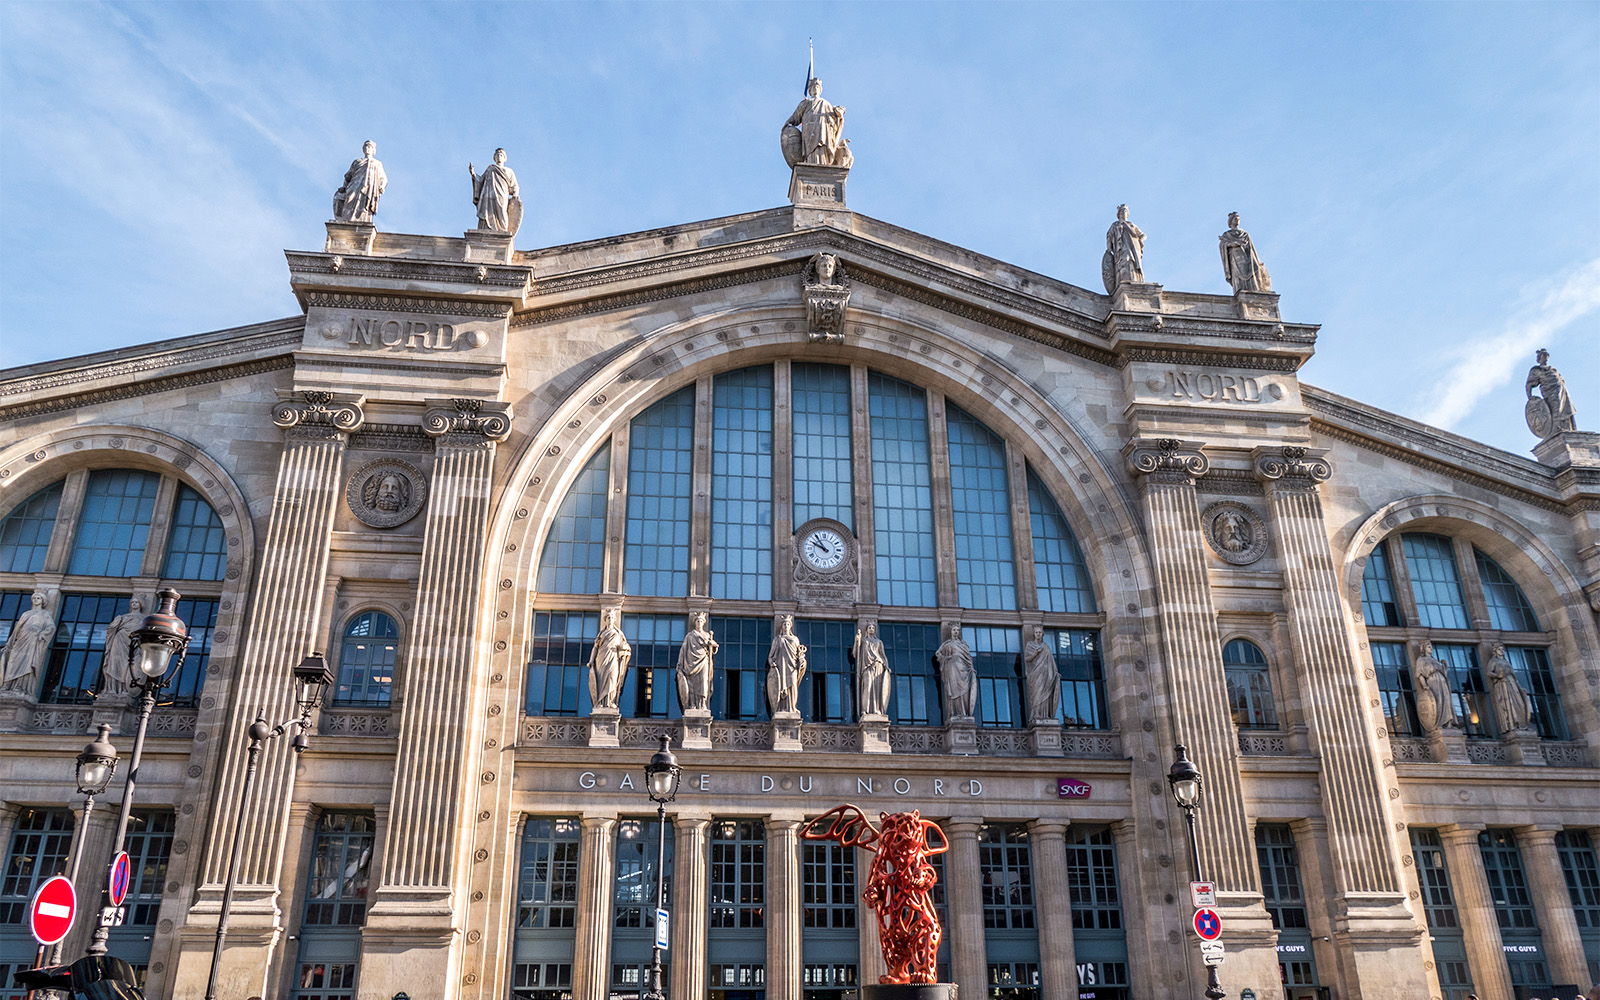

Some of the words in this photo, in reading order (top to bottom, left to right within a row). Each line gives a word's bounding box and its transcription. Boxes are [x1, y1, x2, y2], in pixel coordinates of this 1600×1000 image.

[806, 184, 838, 197] PARIS
[347, 316, 459, 351] NORD
[1168, 371, 1263, 402] NORD
[579, 772, 710, 791] GAE
[761, 775, 813, 794] DU
[857, 777, 984, 797] NORD
[1060, 785, 1090, 795] SNCF
